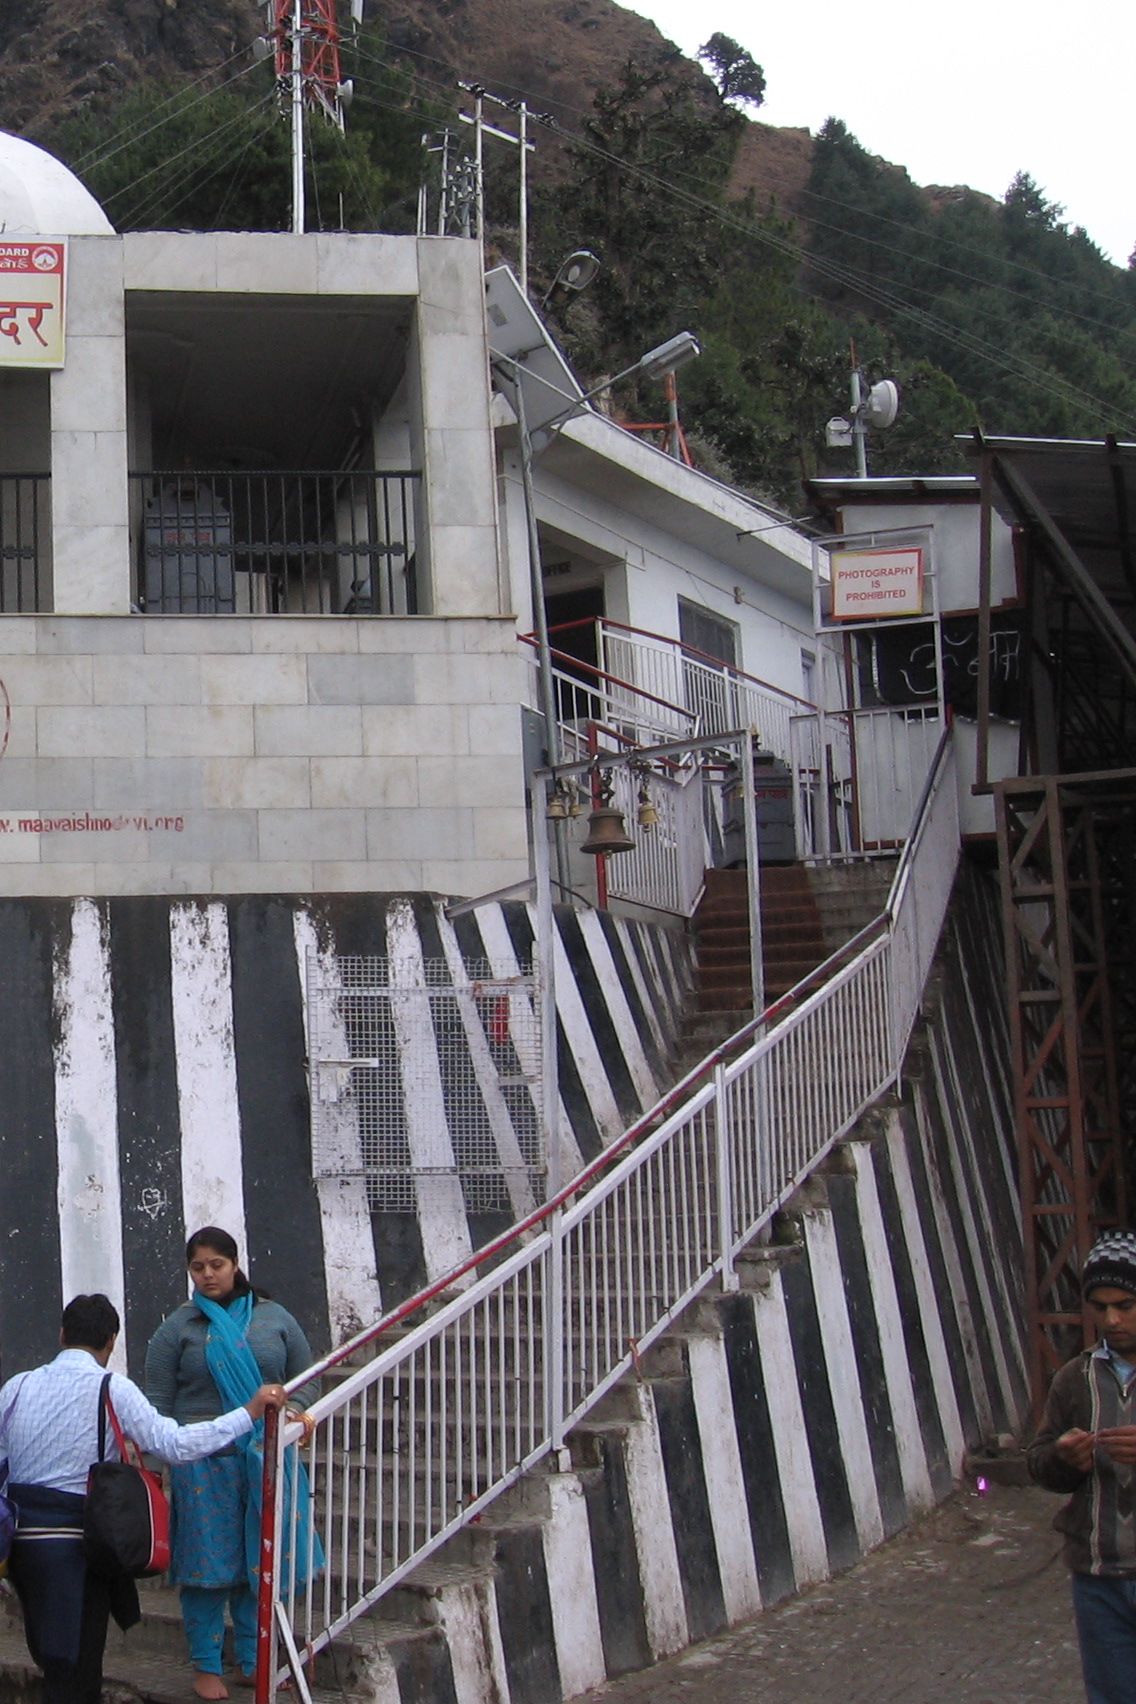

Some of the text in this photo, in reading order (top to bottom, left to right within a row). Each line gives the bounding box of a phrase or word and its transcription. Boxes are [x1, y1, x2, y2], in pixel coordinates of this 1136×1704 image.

[838, 566, 915, 580] PHOTOGRAPHY
[871, 580, 881, 588] IS
[846, 589, 906, 602] PROHIBITED
